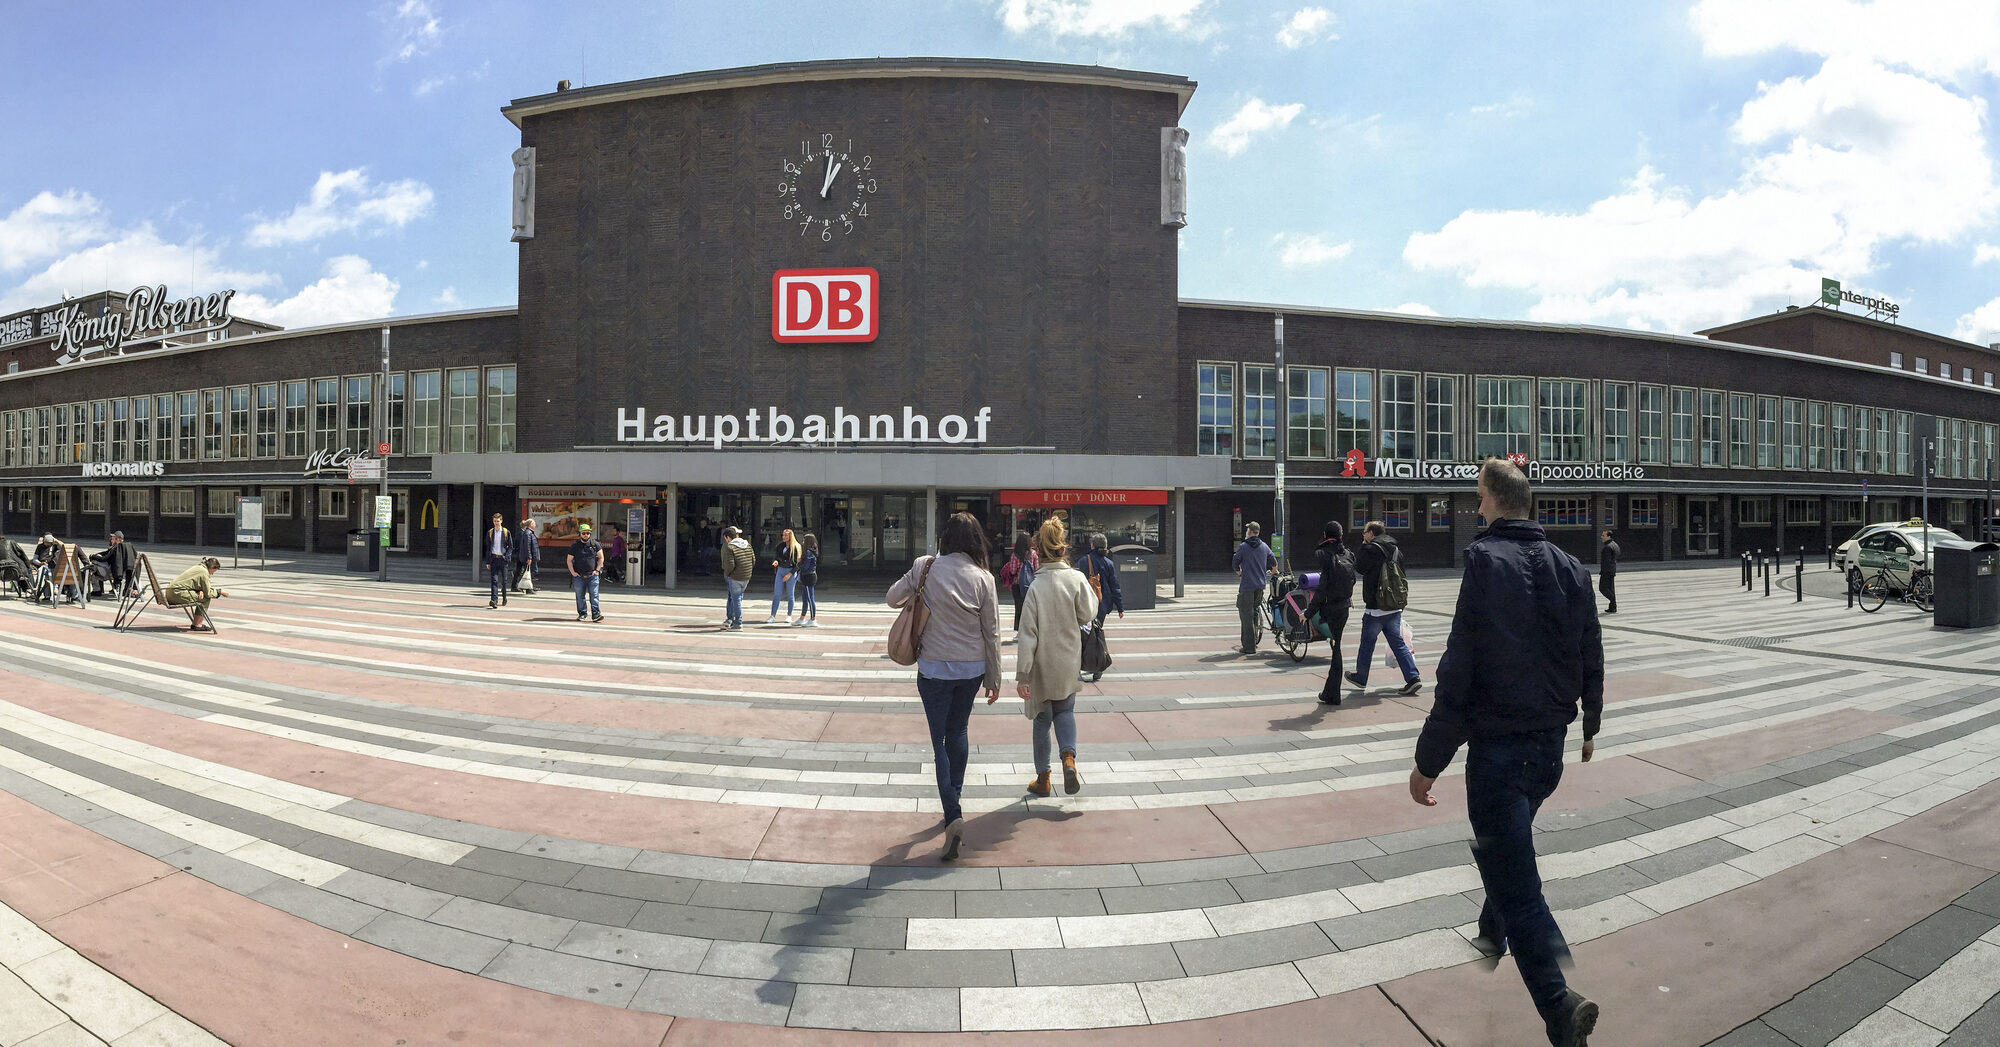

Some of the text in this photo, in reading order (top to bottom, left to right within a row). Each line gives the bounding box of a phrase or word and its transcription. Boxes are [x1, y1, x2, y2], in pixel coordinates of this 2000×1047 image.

[802, 140, 810, 155] 11
[822, 133, 833, 148] 12
[849, 139, 852, 153] 1
[783, 158, 796, 173] 10
[863, 155, 872, 171] 2
[778, 183, 788, 198] 9
[867, 178, 877, 194] 3
[784, 204, 794, 220] 8
[858, 202, 869, 218] 4
[800, 222, 809, 236] 7
[821, 226, 832, 242] 6
[844, 220, 854, 235] 5
[786, 281, 864, 331] DB
[50, 284, 236, 357] König Pilsener
[616, 406, 992, 450] Hauptbahnhof
[82, 461, 165, 477] McDonald's
[528, 488, 646, 499] Rostbratwurst Currywurst
[1090, 491, 1127, 502] DÖNER
